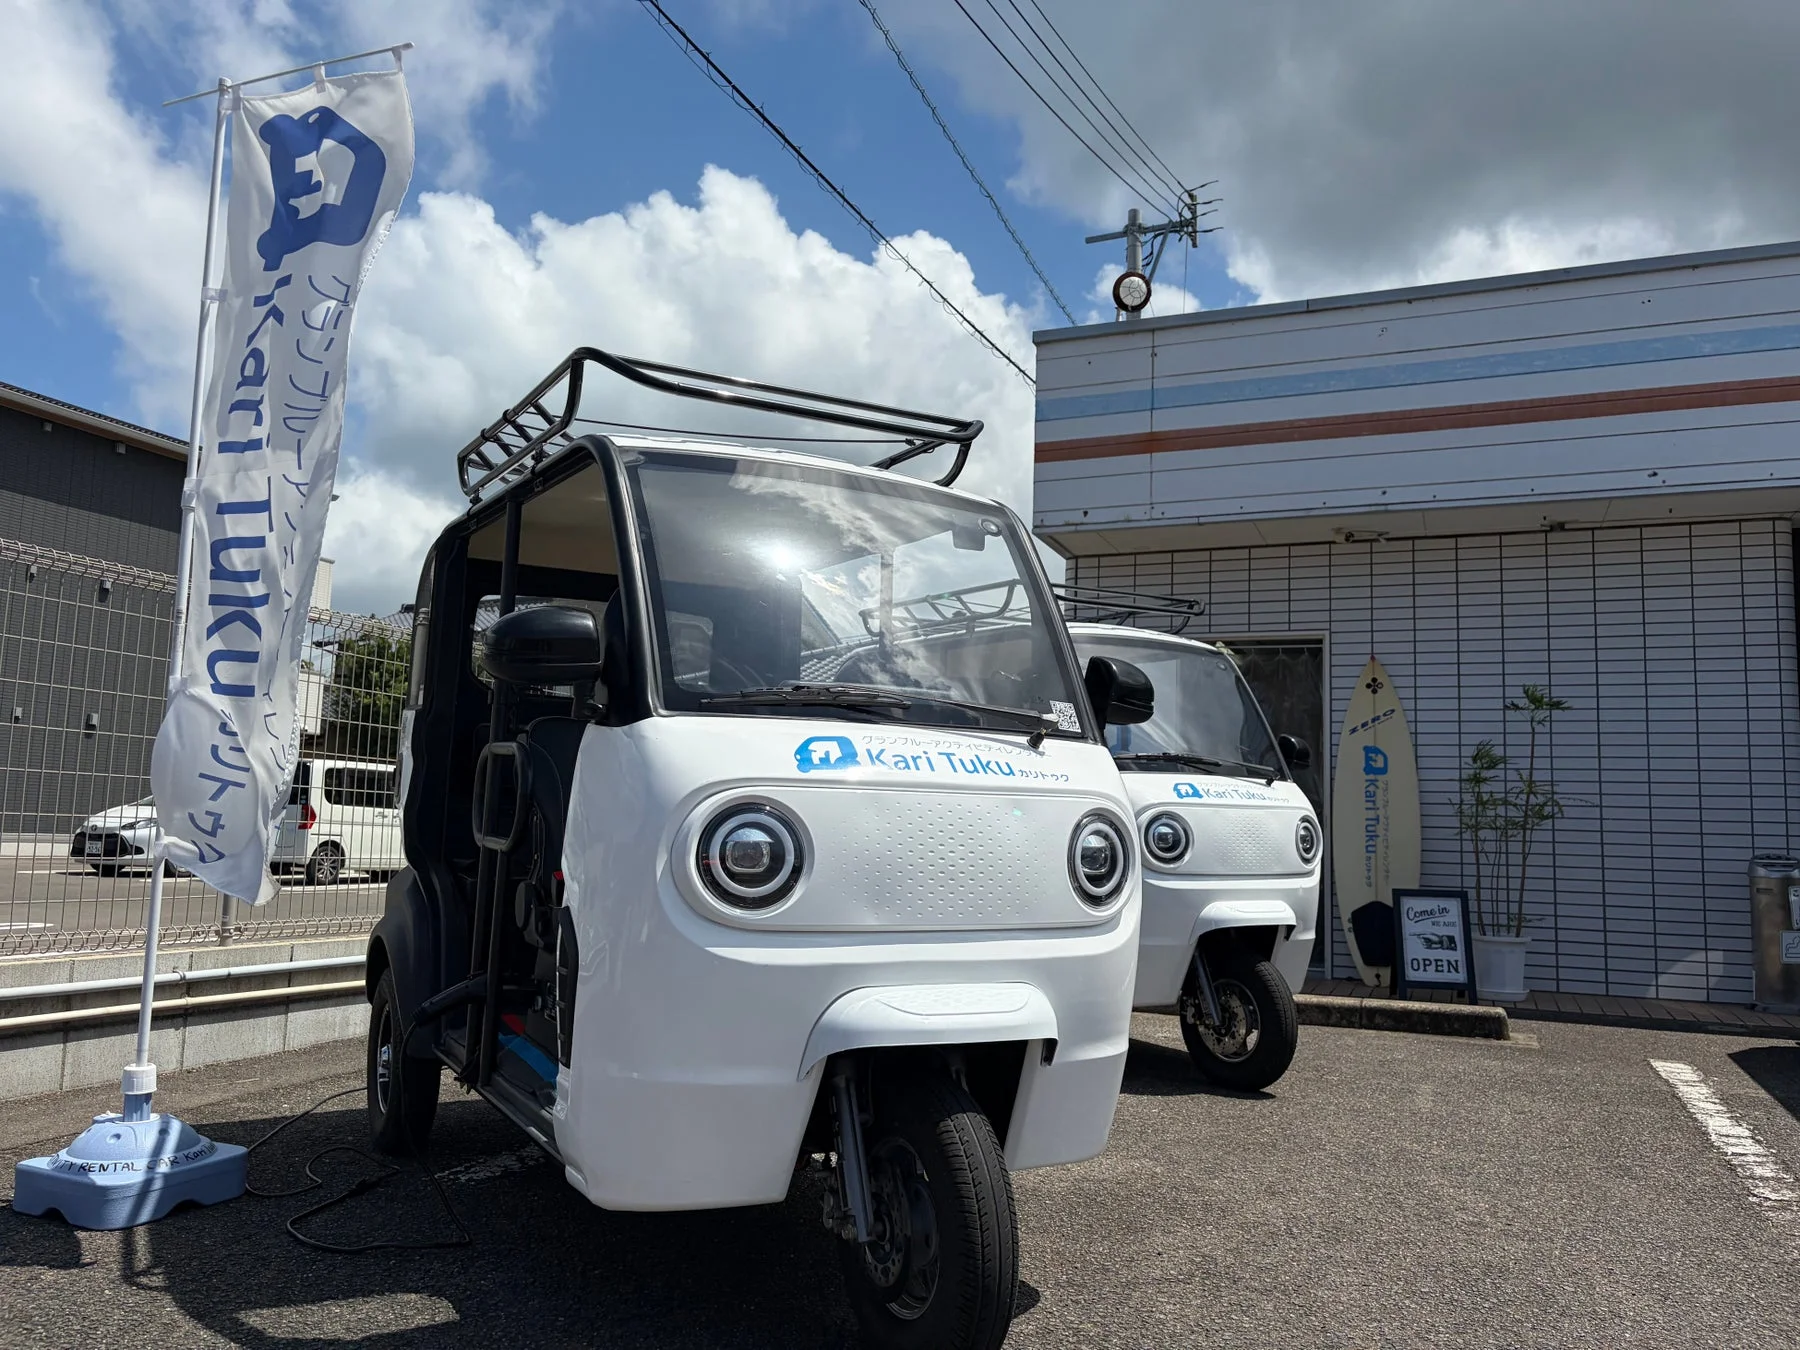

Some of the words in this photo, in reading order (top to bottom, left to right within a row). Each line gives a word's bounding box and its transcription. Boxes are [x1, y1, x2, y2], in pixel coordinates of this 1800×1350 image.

[218, 273, 292, 453] Kari
[206, 476, 274, 698] Tuku
[1348, 708, 1396, 736] ZERO
[865, 748, 936, 772] Kari
[938, 751, 1016, 777] Tuku
[1202, 788, 1234, 799] Kari
[1231, 789, 1268, 801] Tuku
[1365, 778, 1380, 811] Kari
[1365, 815, 1381, 854] Tuku
[1406, 906, 1438, 922] Come
[1437, 904, 1450, 915] in
[1410, 957, 1460, 974] OPEN
[77, 1161, 142, 1173] RENTAL
[146, 1156, 180, 1170] CAR
